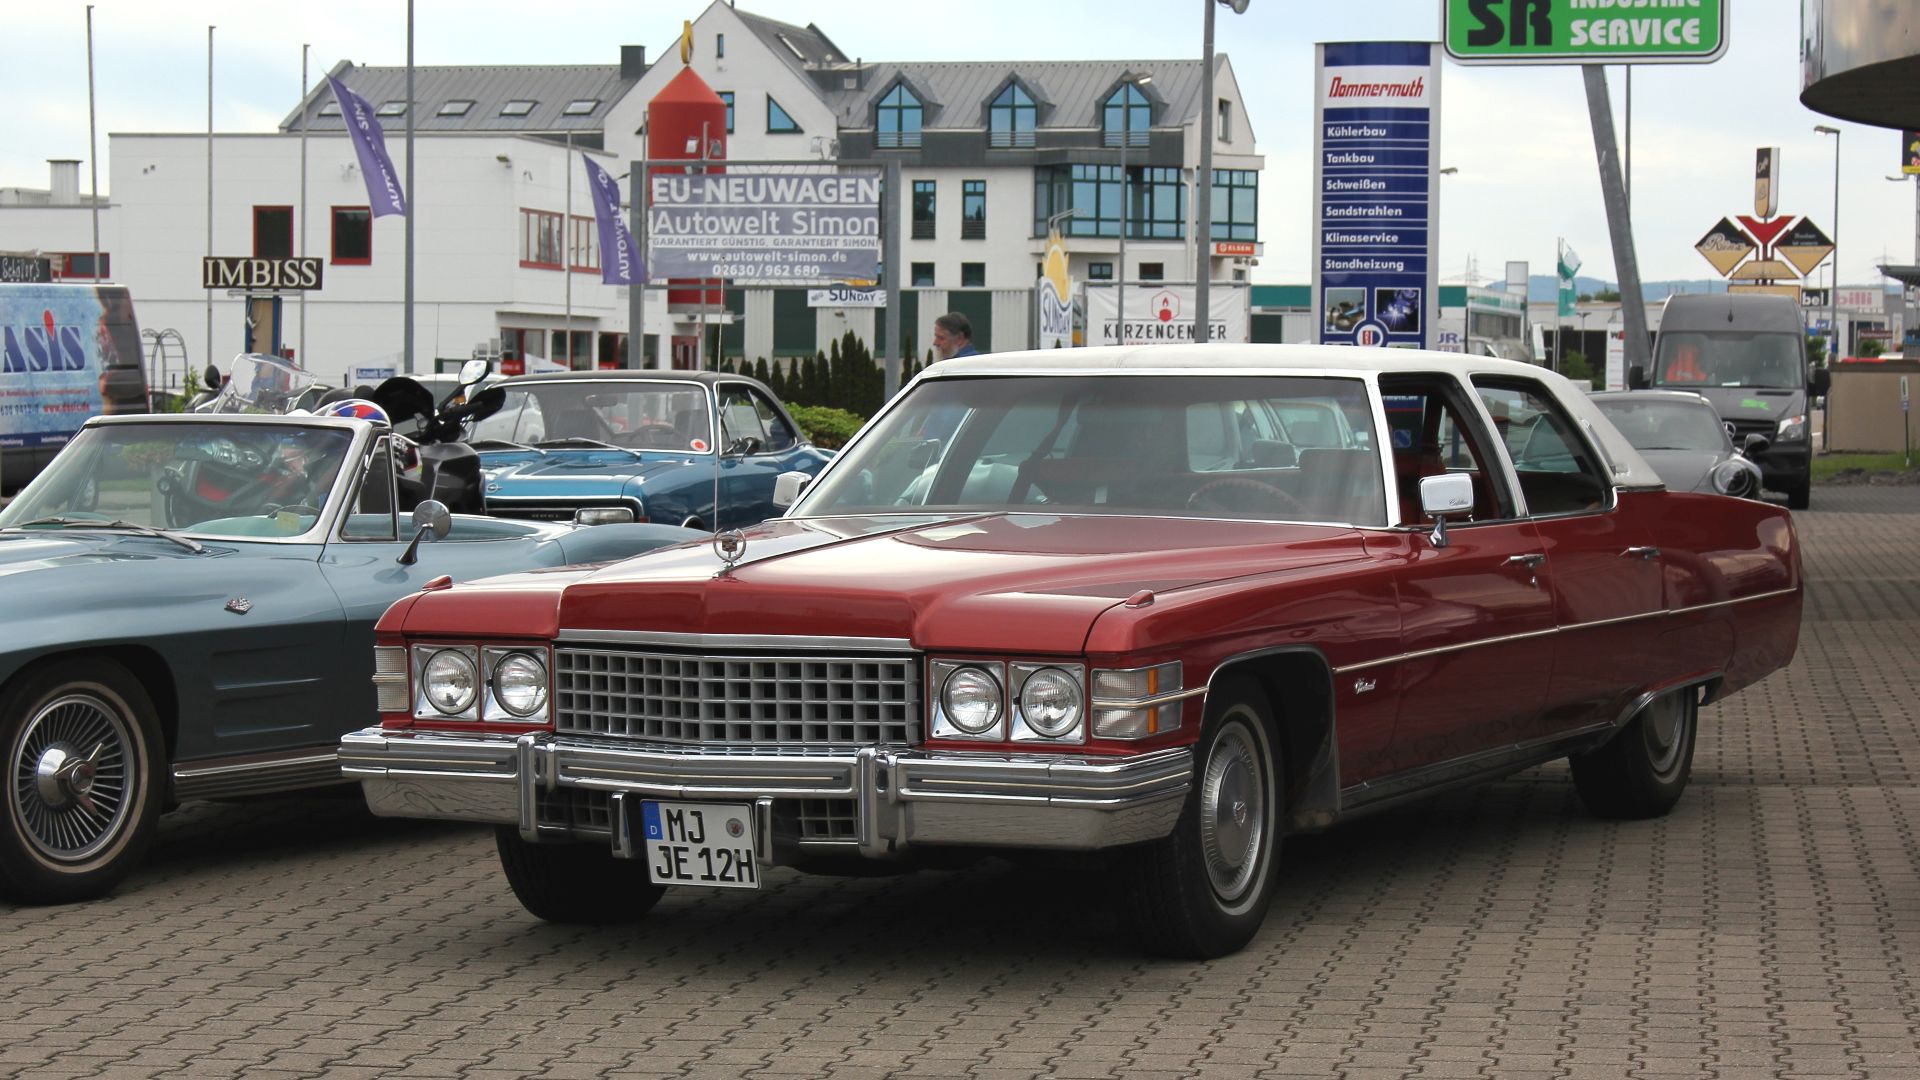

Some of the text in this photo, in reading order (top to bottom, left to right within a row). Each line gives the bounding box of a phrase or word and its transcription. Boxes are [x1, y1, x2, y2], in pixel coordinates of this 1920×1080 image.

[1467, 0, 1553, 46] SR
[1570, 18, 1700, 46] SERVICE
[1328, 75, 1424, 98] Dommermuth
[1327, 125, 1387, 137] Kühlerbau
[1326, 153, 1375, 164] Tankbau
[652, 177, 879, 203] EU-NEUWAGEN
[1326, 179, 1386, 190] Schweißen
[1325, 206, 1402, 217] Sandstrahlen
[653, 210, 879, 236] Autowelt Simon
[652, 237, 717, 247] GARANTIERT
[721, 236, 769, 249] GÜNSTIG,
[773, 238, 838, 247] GARANTIERT
[1325, 232, 1399, 243] Klimaservice
[687, 251, 848, 263] www.autowelt-simon.de
[712, 264, 820, 277] 02630/962 680
[1324, 259, 1404, 272] Standheizung
[205, 259, 318, 287] IMBISS
[829, 288, 877, 303] SUNDAY
[1103, 323, 1227, 341] KRZENCENER
[650, 825, 658, 835] D
[665, 808, 706, 844] MJ
[655, 845, 755, 883] JE 12H
